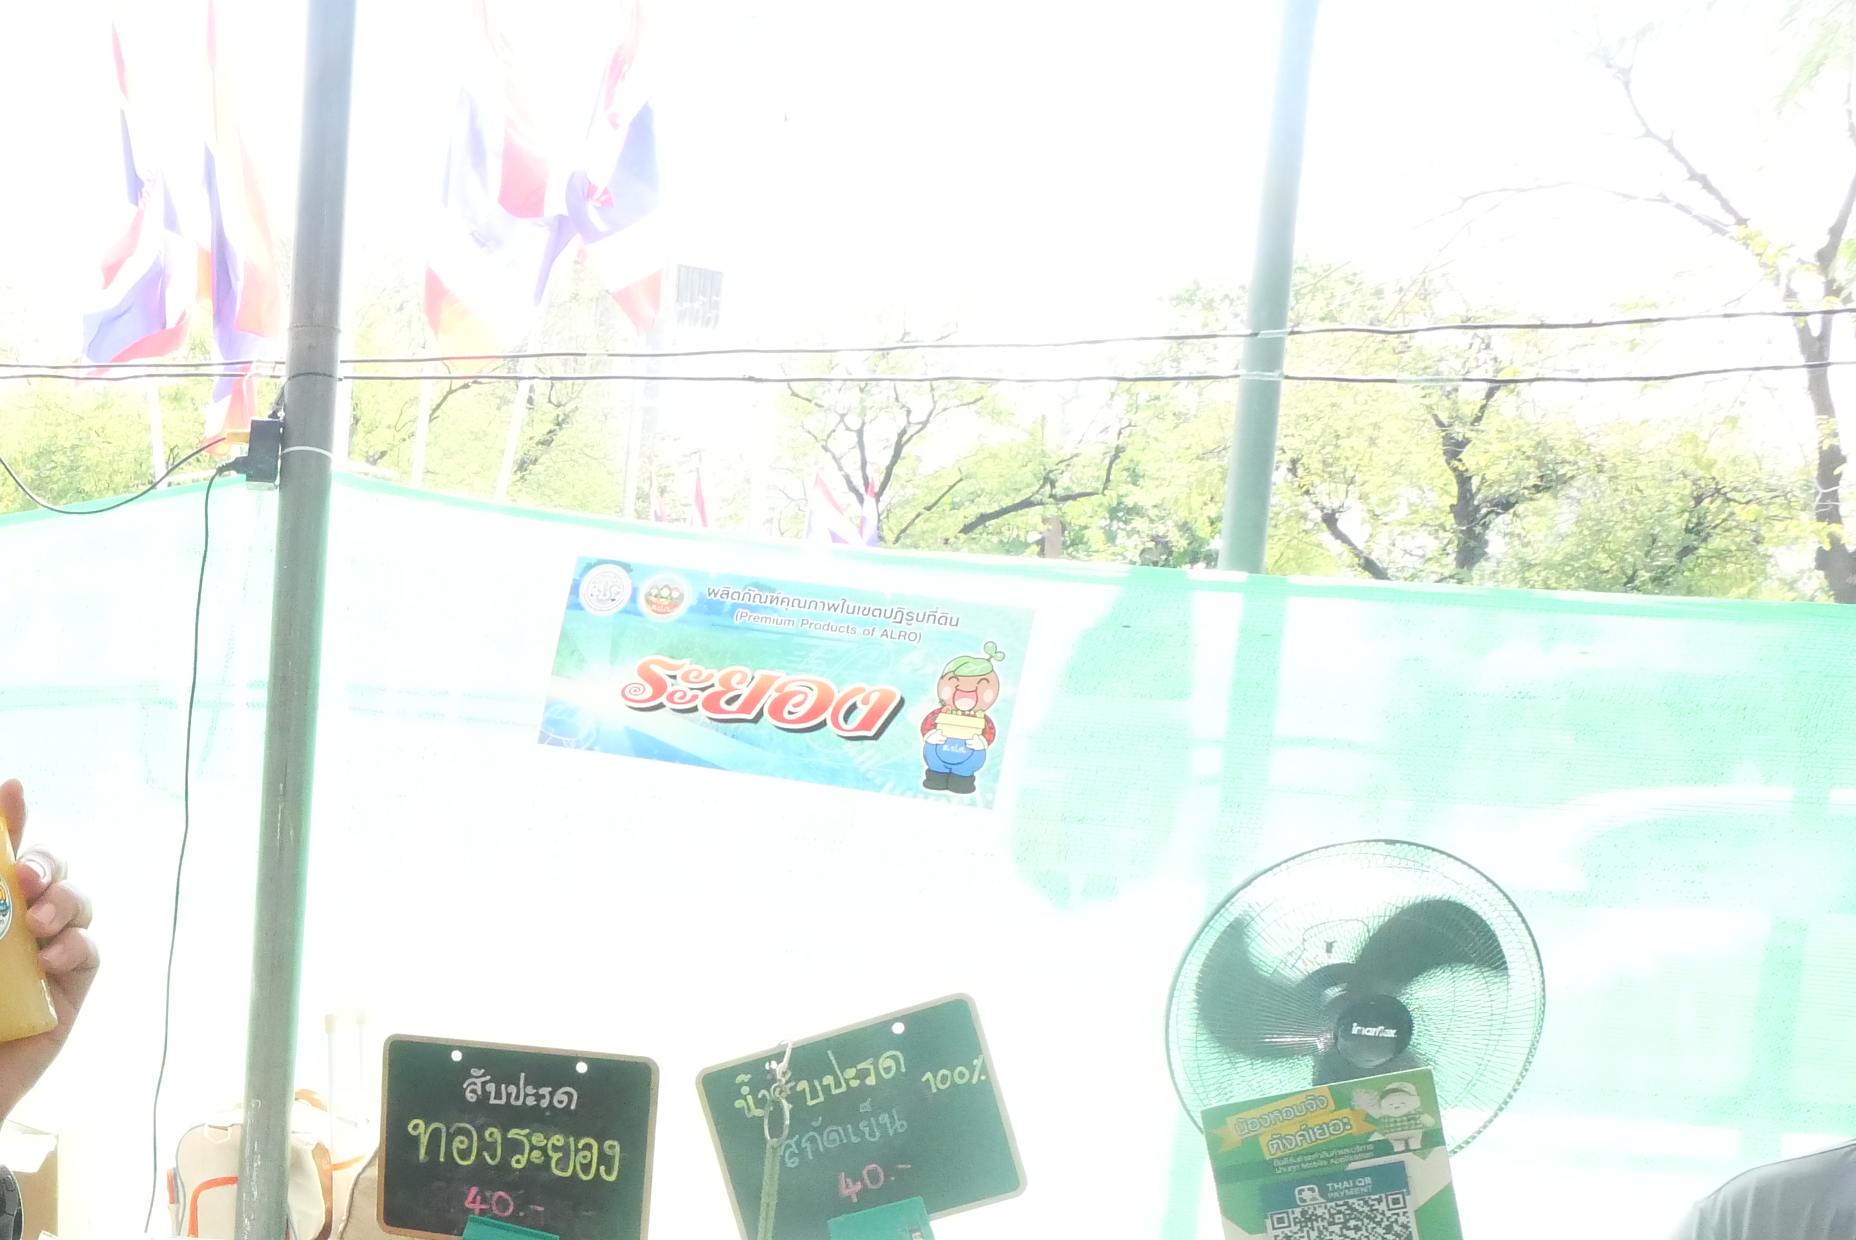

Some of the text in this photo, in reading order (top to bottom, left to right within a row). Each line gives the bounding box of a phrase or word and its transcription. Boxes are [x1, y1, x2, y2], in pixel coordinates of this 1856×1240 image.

[707, 586, 960, 628] ผลิตภัณฑ์คุณภาพในเขตปฏิรูปที่ดิน
[734, 609, 922, 645] (Premium Products of ALRO)
[621, 656, 902, 740] ระยอง
[463, 1068, 579, 1110] สับปะรด
[921, 1054, 987, 1093] 100%
[407, 1118, 621, 1182] ทองระยอง
[780, 1098, 909, 1168] สกัดเย็น
[1266, 1116, 1353, 1157] ตังค์เยอะ
[1325, 1176, 1373, 1192] THAI QR
[1327, 1185, 1373, 1199] PAYMENT
